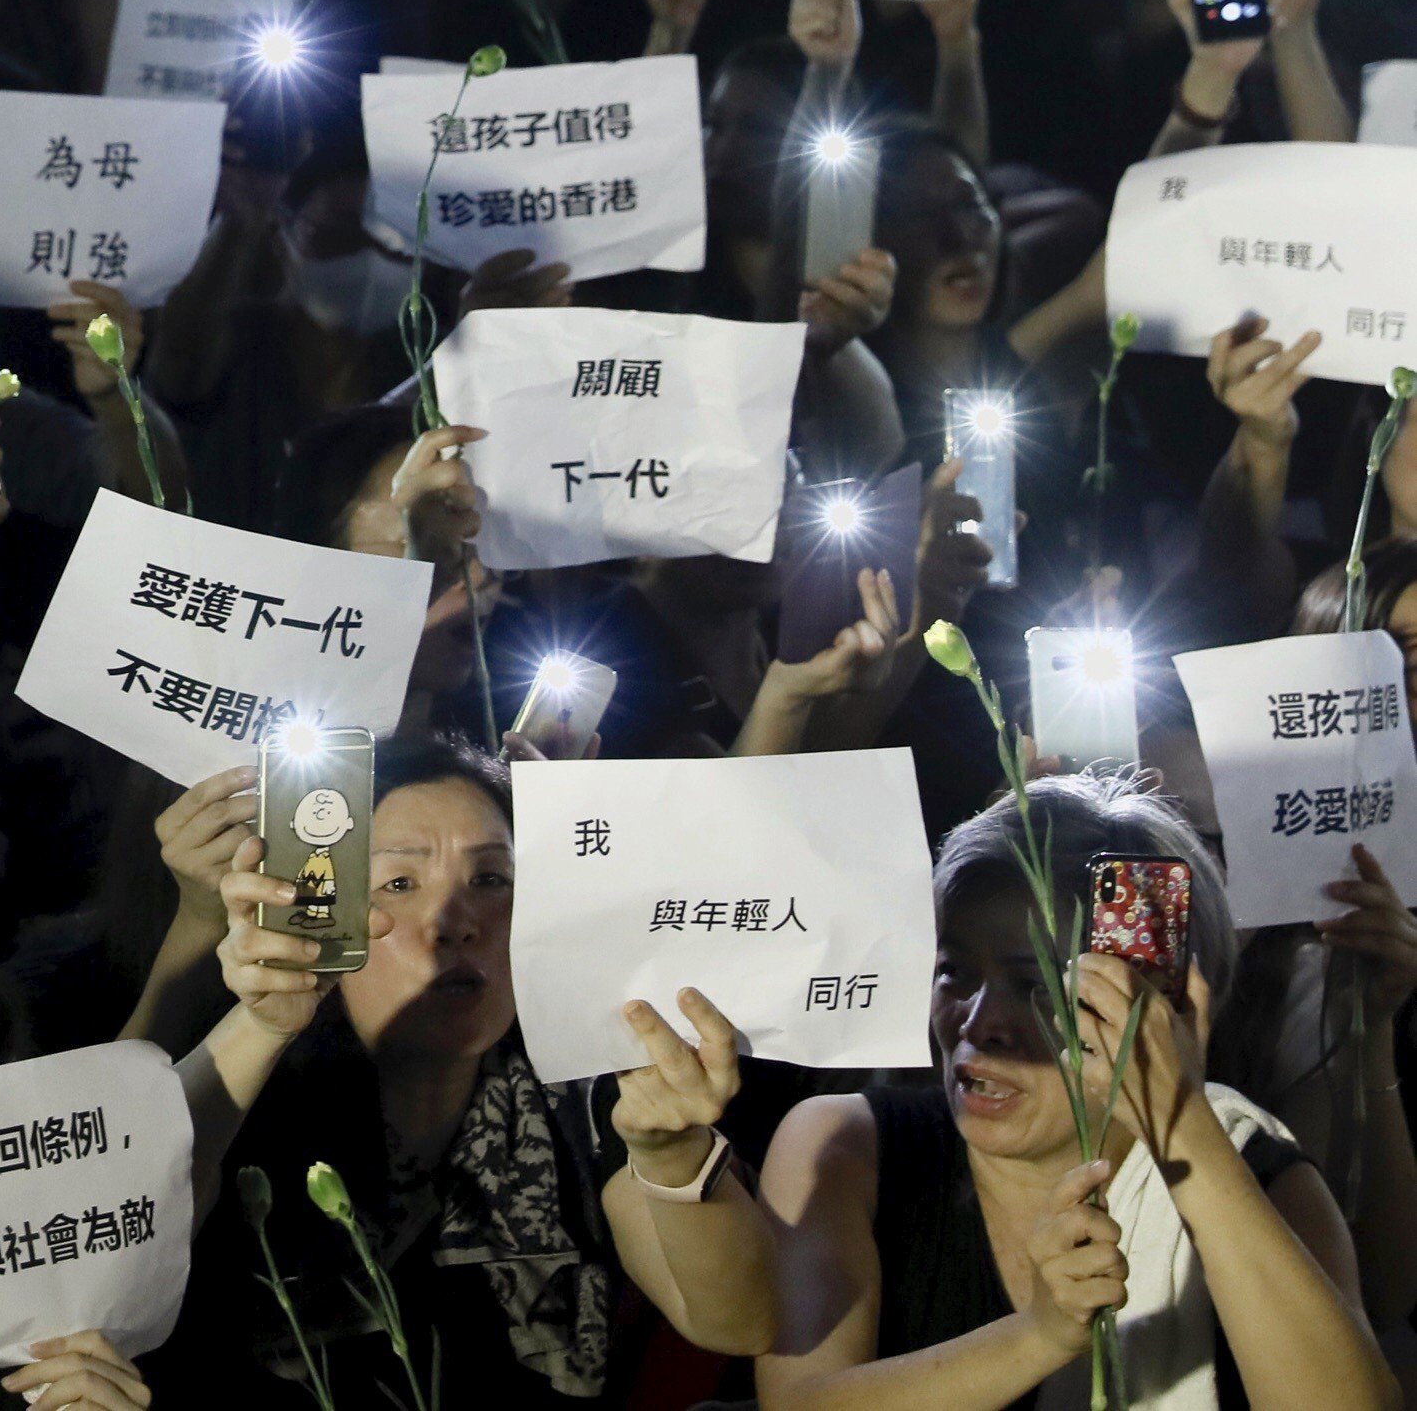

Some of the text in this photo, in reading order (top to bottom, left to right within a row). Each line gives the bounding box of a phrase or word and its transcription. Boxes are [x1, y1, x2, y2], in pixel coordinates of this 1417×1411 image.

[428, 97, 633, 157] 還孩子值得
[38, 133, 141, 188] 為母
[437, 175, 640, 229] 珍愛的香港
[1160, 175, 1188, 203] 我
[27, 227, 131, 282] 則強
[1219, 239, 1343, 273] 與年輕人
[1345, 307, 1407, 341] 同行
[570, 355, 663, 402] 關顧
[549, 458, 670, 504] 下一代
[127, 560, 367, 662] 愛護下一代,
[1268, 681, 1401, 741] 還孩子值得
[1271, 777, 1395, 836] 珍愛的香港
[573, 817, 611, 858] 我
[649, 895, 808, 933] 與年輕人
[804, 971, 880, 1012] 同行
